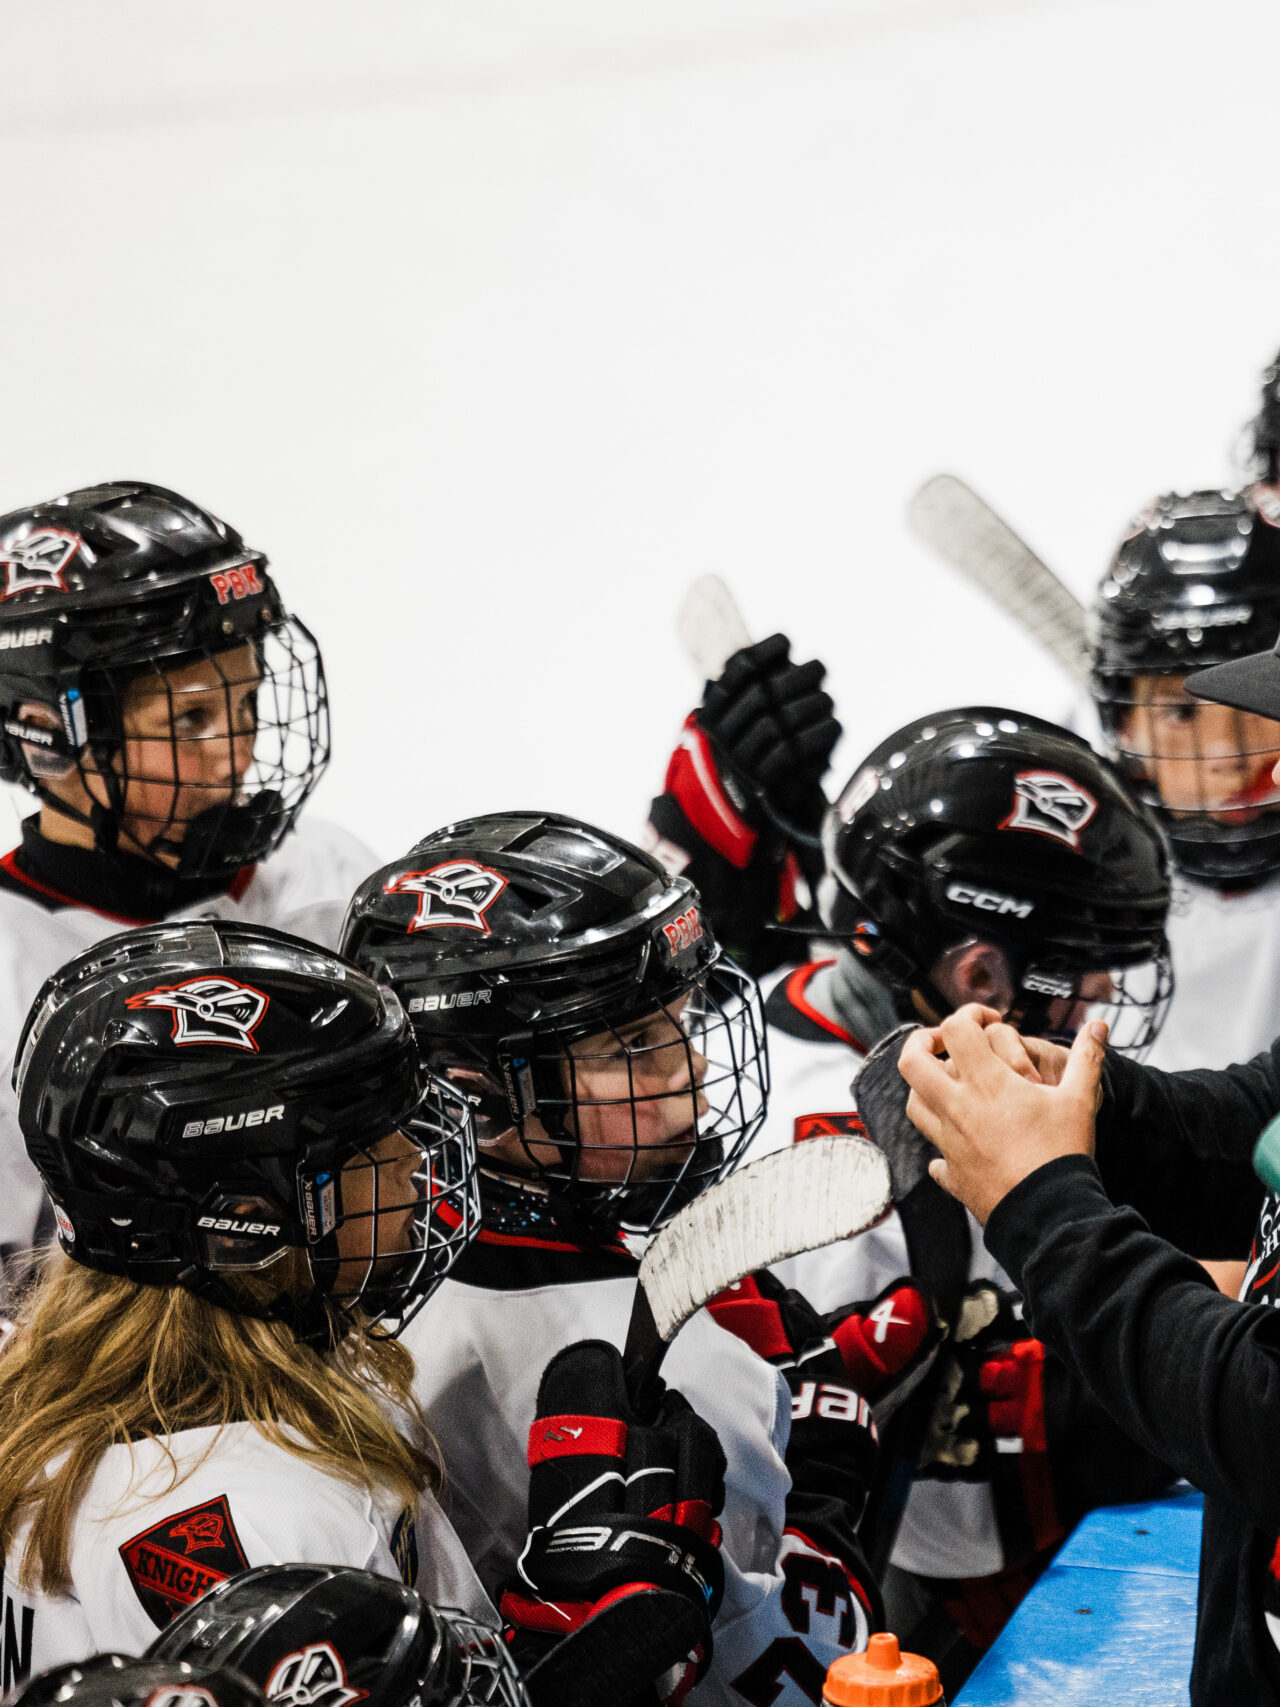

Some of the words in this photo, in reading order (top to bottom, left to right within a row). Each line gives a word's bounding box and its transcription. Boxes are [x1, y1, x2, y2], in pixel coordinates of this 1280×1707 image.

[209, 564, 263, 605] PBK
[0, 627, 53, 650] AUER
[947, 886, 1034, 919] CCM
[662, 907, 703, 957] PBK
[408, 989, 492, 1013] BAUER
[182, 1104, 285, 1138] BAUER
[197, 1216, 281, 1236] BAUER
[135, 1547, 217, 1598] KNIGH
